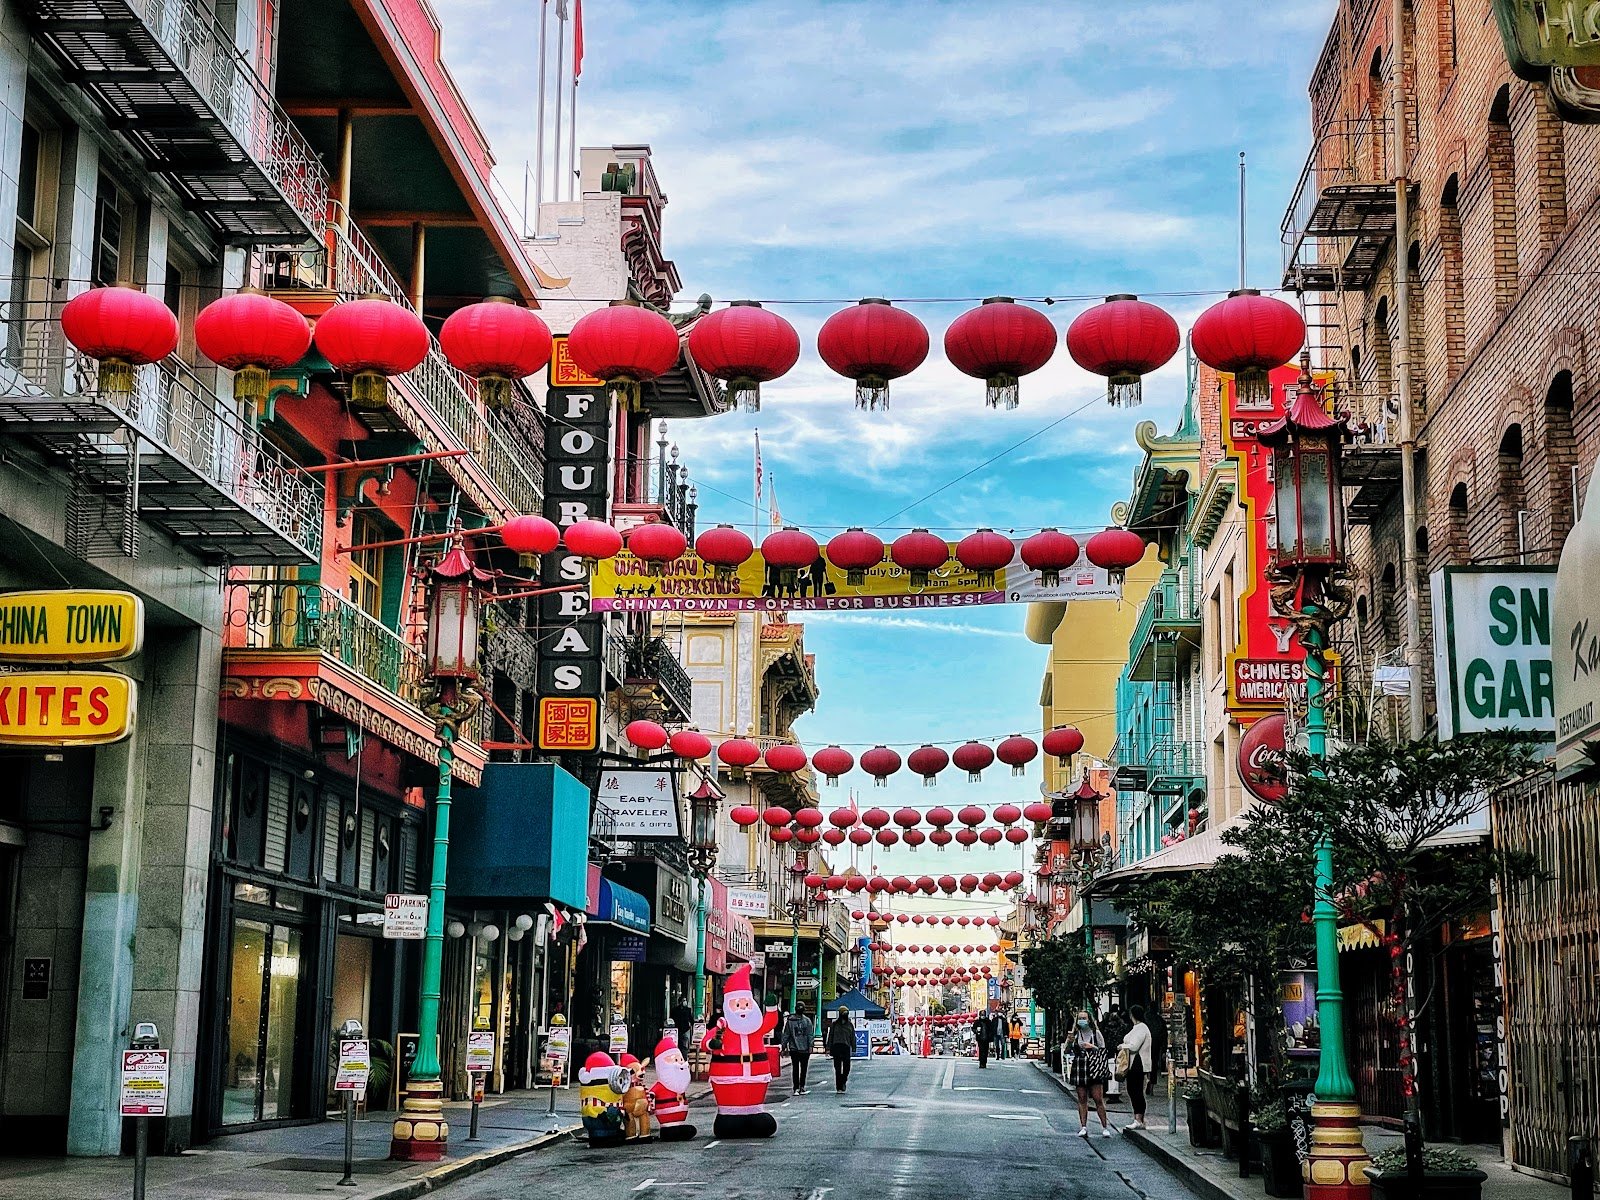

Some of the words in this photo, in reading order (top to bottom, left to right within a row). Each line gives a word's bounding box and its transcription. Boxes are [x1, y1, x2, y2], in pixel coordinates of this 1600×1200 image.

[559, 394, 594, 526] FOUR
[614, 560, 698, 577] WALWAY
[661, 577, 740, 595] WEEKENDS
[612, 599, 728, 610] CHINATOWN
[738, 599, 756, 610] IS
[765, 599, 817, 610] OPEN
[826, 598, 863, 609] FOR
[874, 593, 982, 609] BUSINESS!
[1489, 585, 1550, 646] SN
[0, 605, 48, 645] HINA
[66, 604, 122, 644] TOWN
[553, 556, 590, 690] SEAS
[1240, 681, 1298, 699] AMERICAN
[1464, 658, 1555, 719] GAR
[1559, 701, 1593, 739] RESTAURANT
[603, 808, 668, 817] TRAVELER
[619, 795, 654, 803] EASY
[386, 896, 400, 908] NO
[401, 899, 426, 908] PARKING
[1408, 1009, 1419, 1093] SHO
[1497, 1015, 1509, 1120] SHOP
